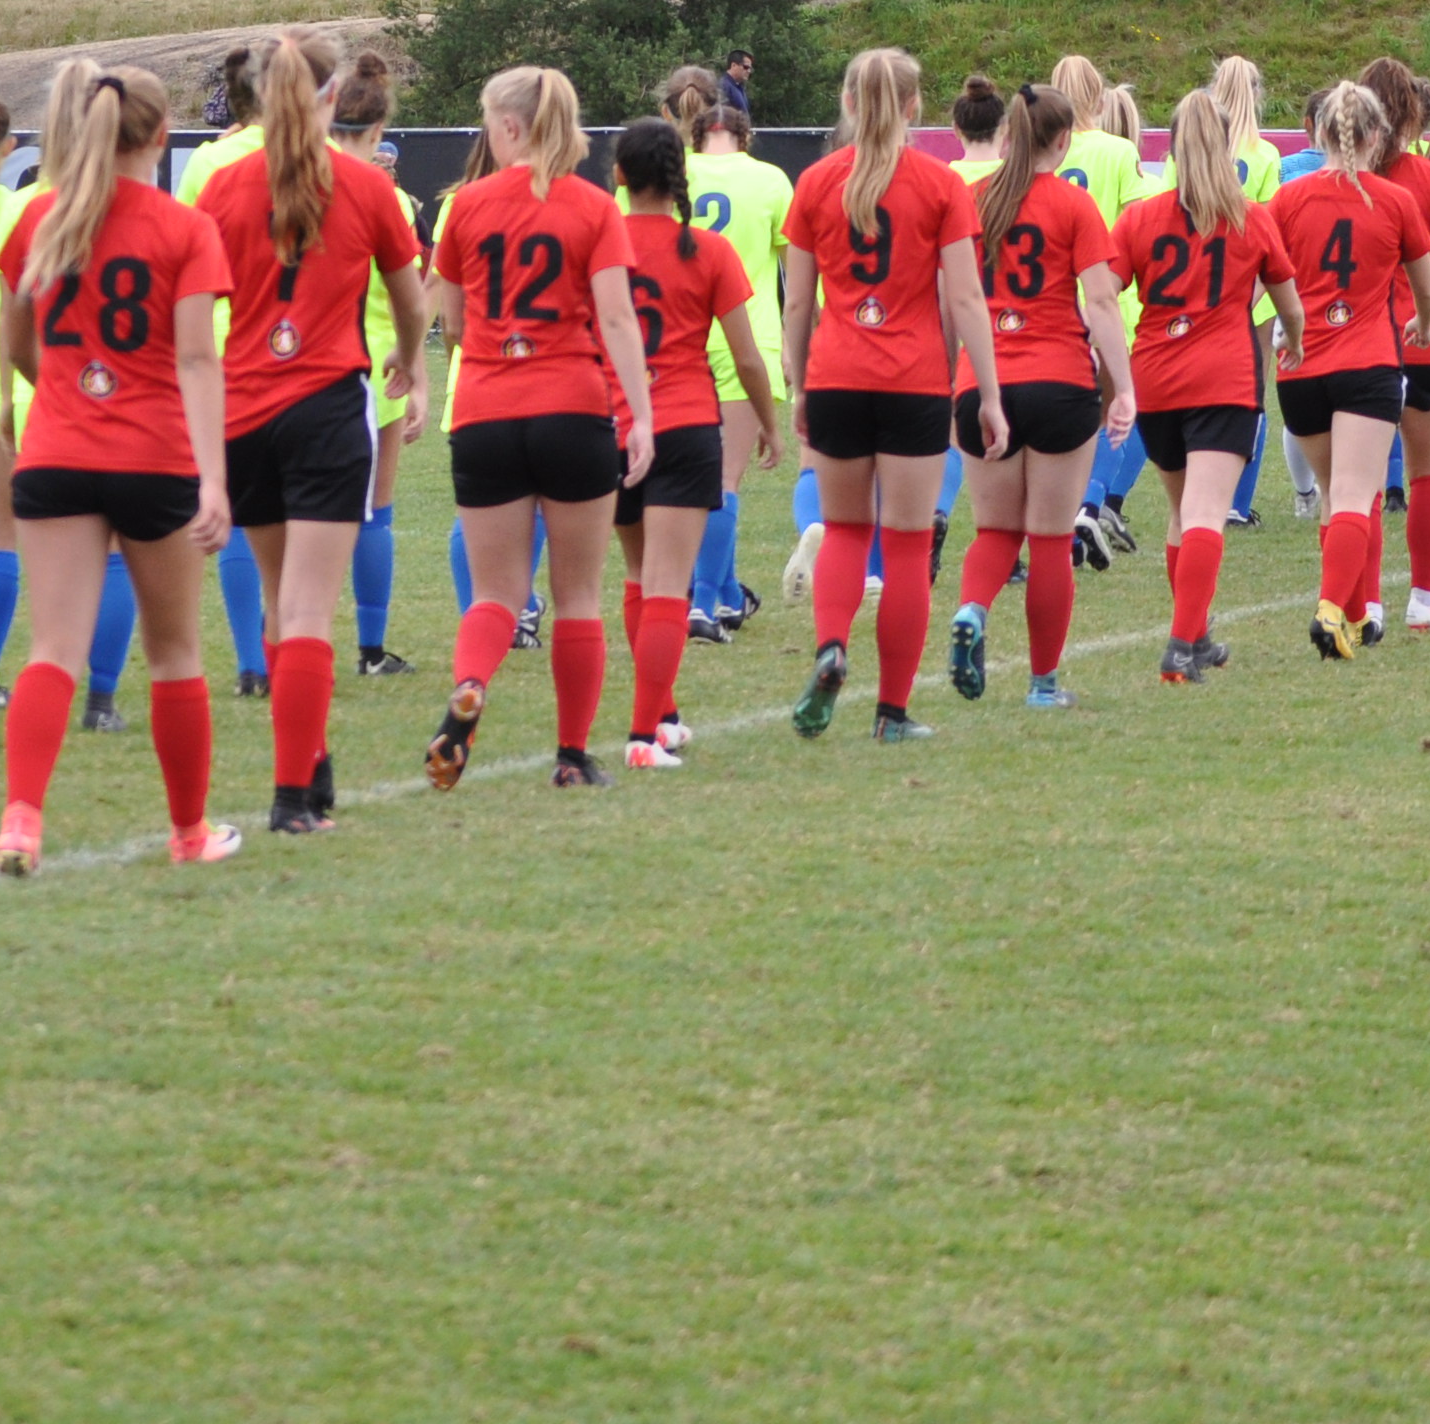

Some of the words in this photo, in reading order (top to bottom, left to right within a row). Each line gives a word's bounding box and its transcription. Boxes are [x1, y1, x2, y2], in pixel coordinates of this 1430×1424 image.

[478, 232, 564, 322] 12
[849, 205, 892, 285] 9
[1147, 234, 1226, 308] 21
[1320, 218, 1357, 289] 4
[44, 257, 151, 352] 28
